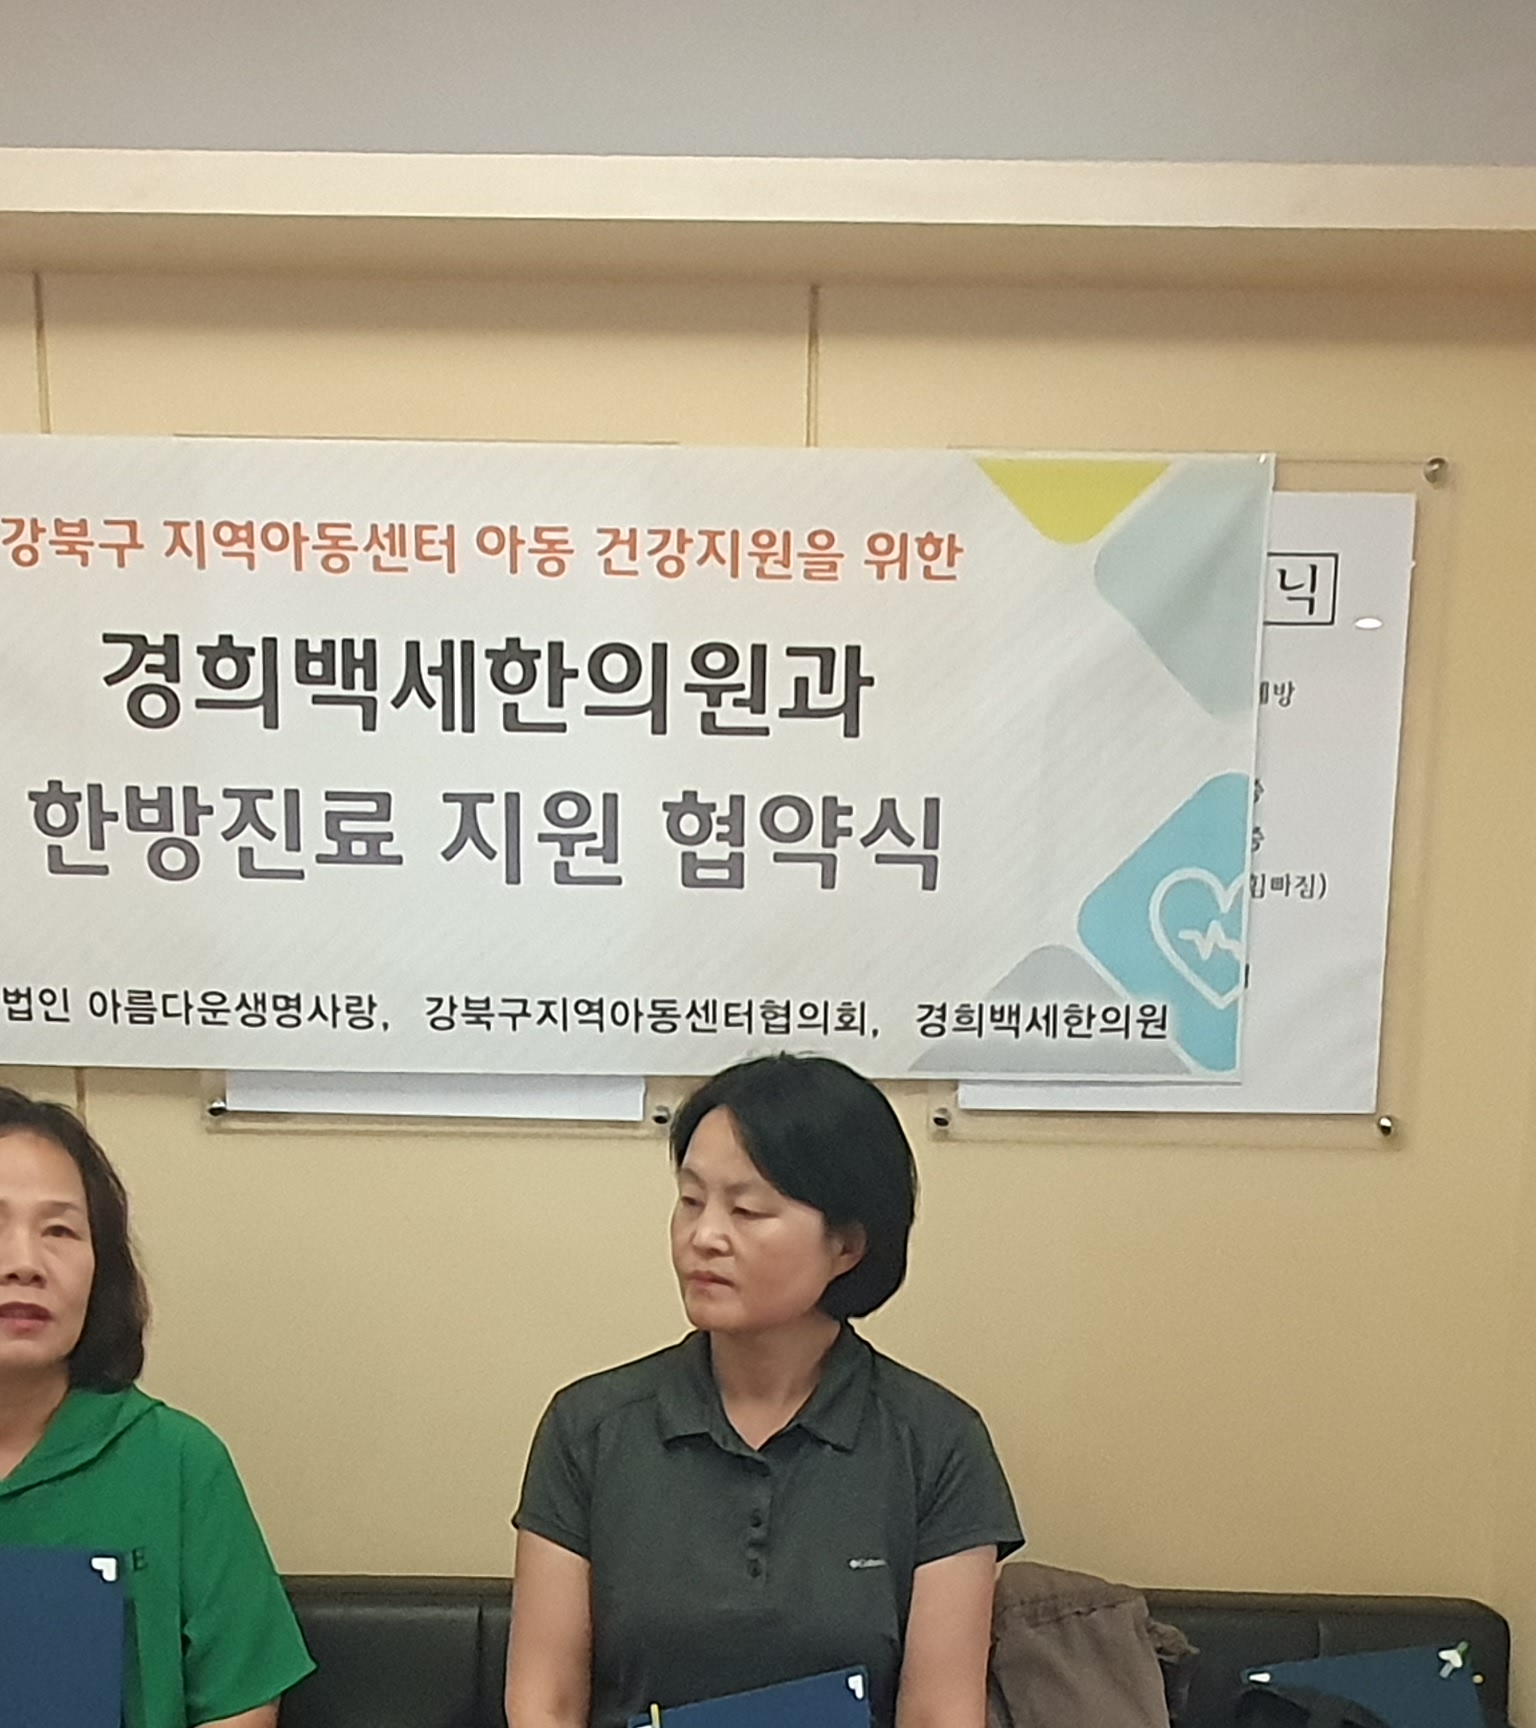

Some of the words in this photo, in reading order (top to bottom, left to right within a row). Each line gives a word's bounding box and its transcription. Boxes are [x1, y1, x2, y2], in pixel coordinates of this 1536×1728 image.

[1, 516, 145, 569] 강북구
[163, 519, 458, 574] 지역아동센터
[475, 524, 576, 578] 아동
[595, 524, 846, 582] 건강지원을
[863, 529, 965, 583] 위한
[101, 630, 875, 739] 경희백세한의원과
[27, 778, 404, 881] 한방진료
[440, 790, 625, 887] 지원
[661, 789, 943, 892] 협약식
[86, 986, 392, 1034] 아름다운생명사랑,
[423, 994, 882, 1041] 강북구지역아동센터협의회,
[914, 1000, 1170, 1041] 경희백세한의원
